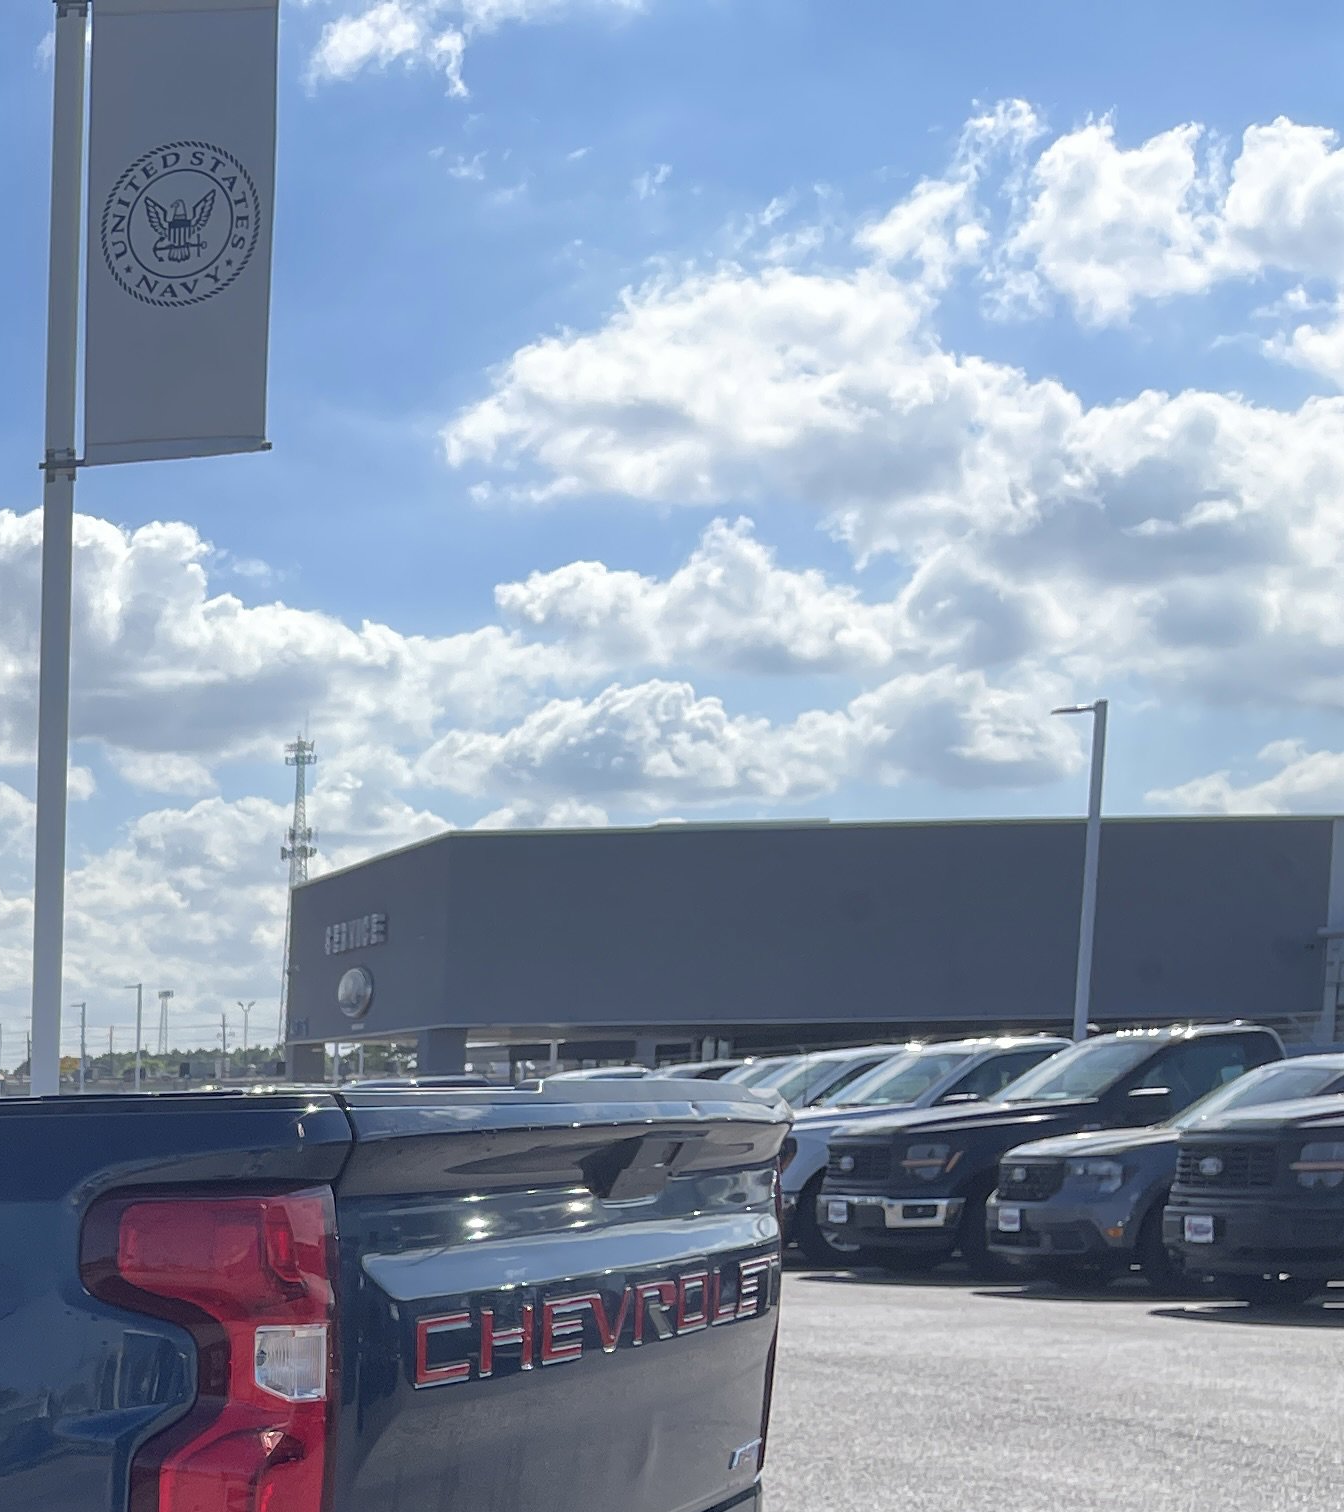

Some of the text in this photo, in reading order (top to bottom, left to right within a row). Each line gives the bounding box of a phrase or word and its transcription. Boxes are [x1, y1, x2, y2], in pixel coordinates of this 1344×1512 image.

[111, 150, 250, 260] UNITED STATES
[135, 265, 221, 299] NAVY
[414, 1250, 779, 1389] CHEVROLET
